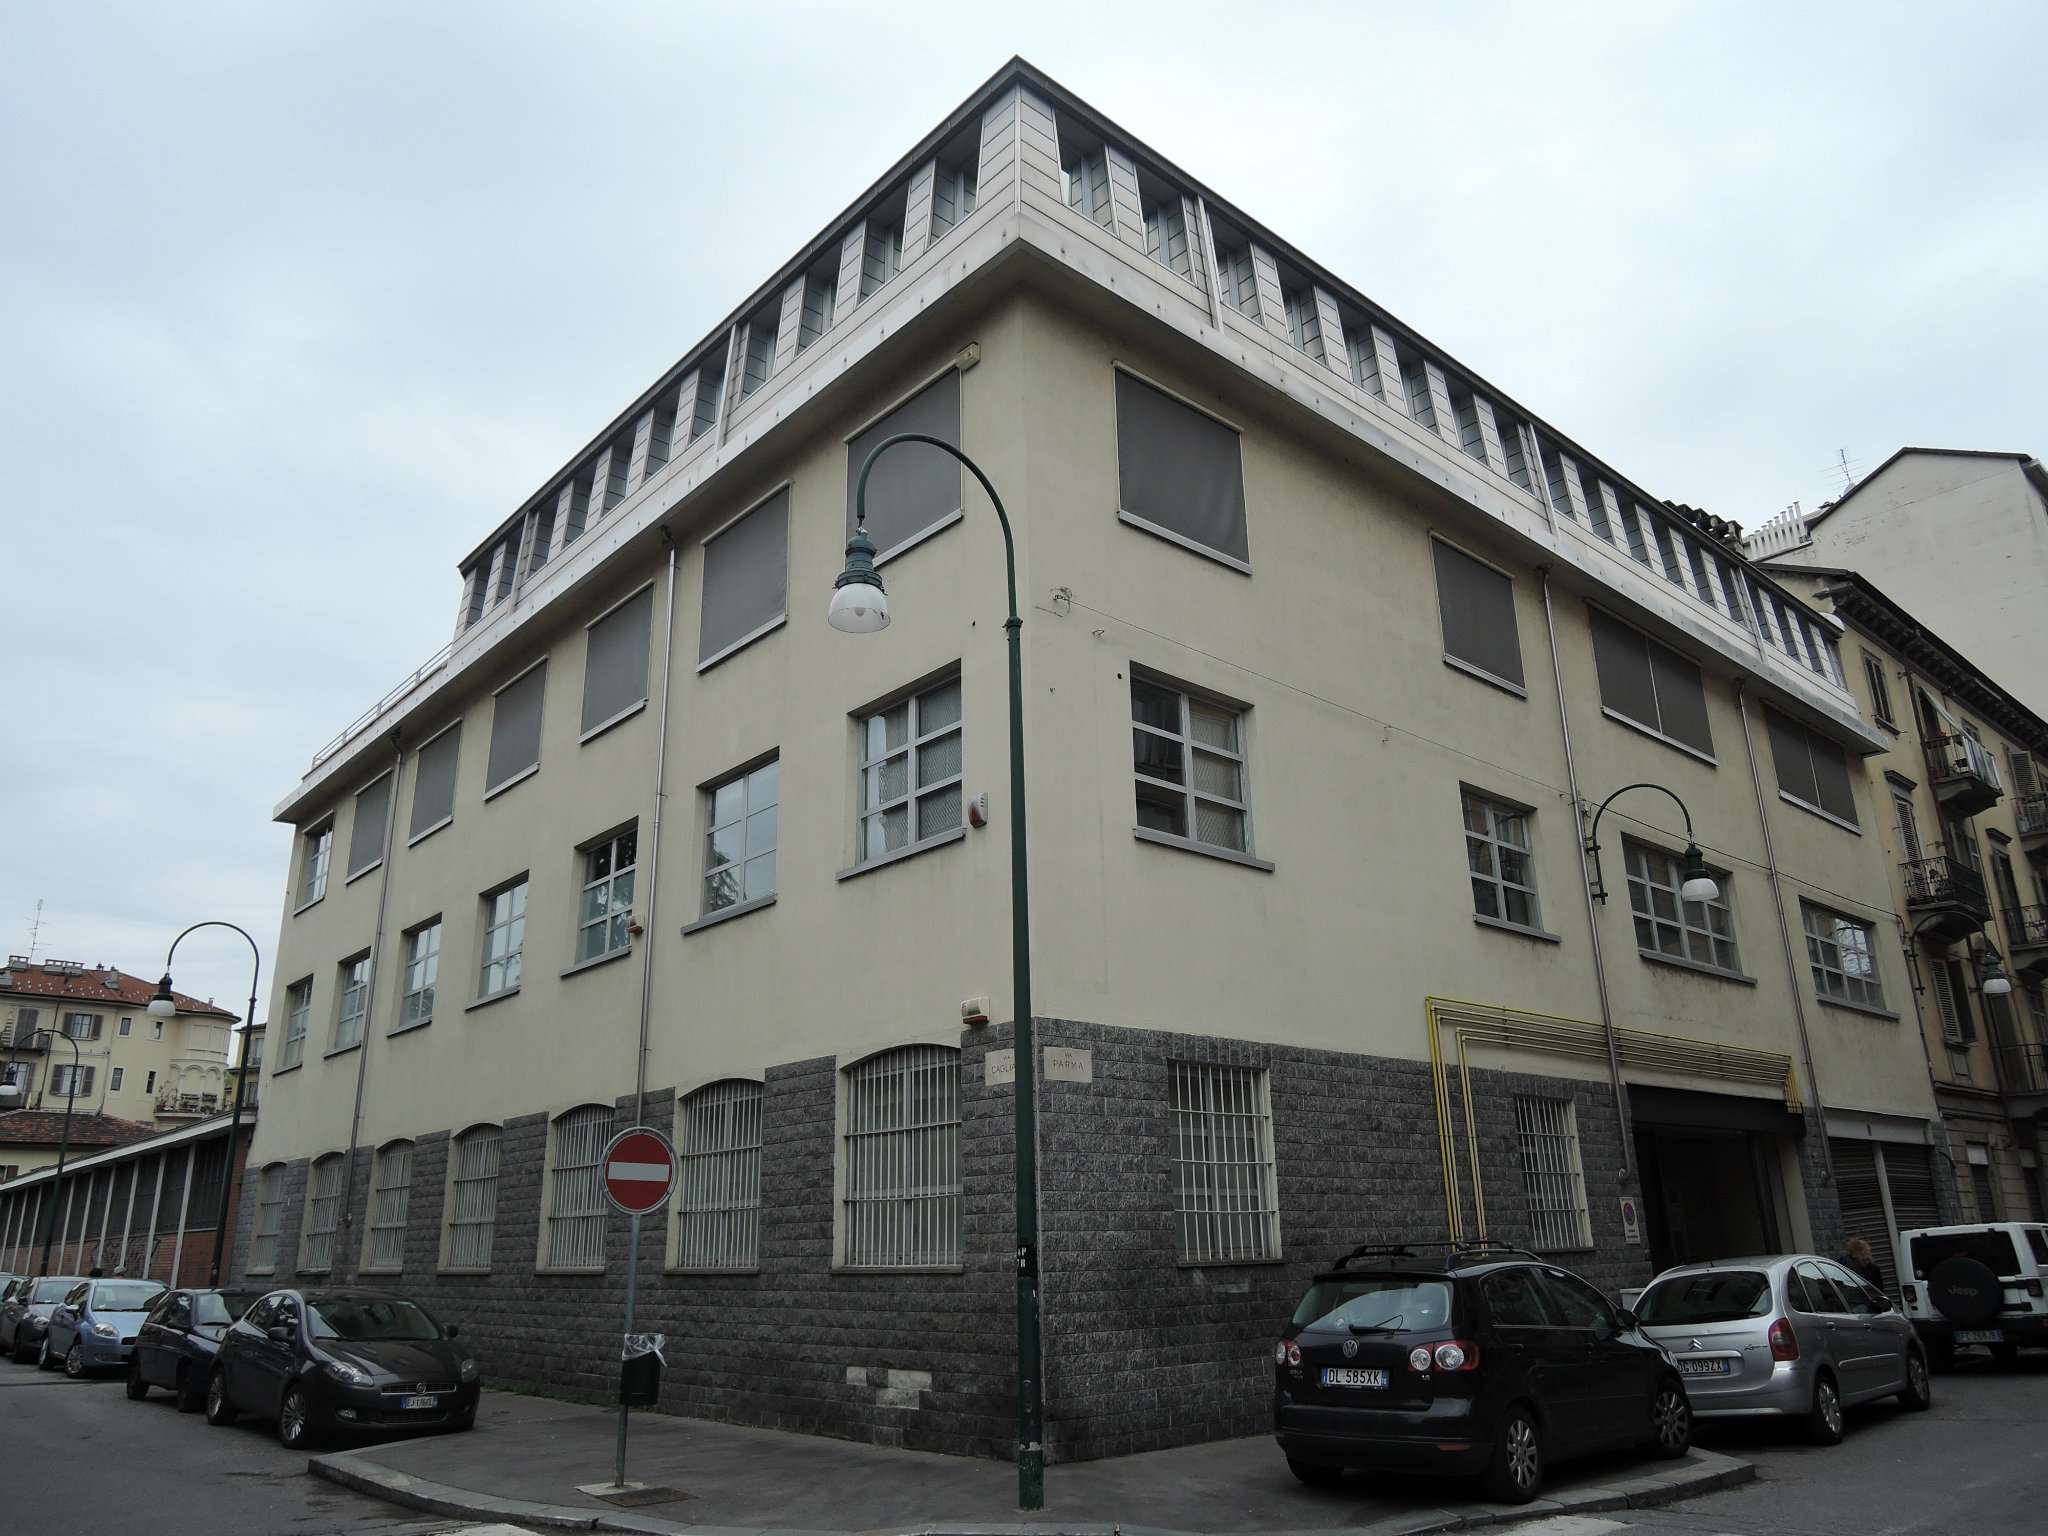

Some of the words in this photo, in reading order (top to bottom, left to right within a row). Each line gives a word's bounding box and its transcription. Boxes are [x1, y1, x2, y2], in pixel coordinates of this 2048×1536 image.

[1053, 1059, 1084, 1071] PARMA
[1328, 1369, 1342, 1384] DL
[1345, 1370, 1380, 1385] 585XK
